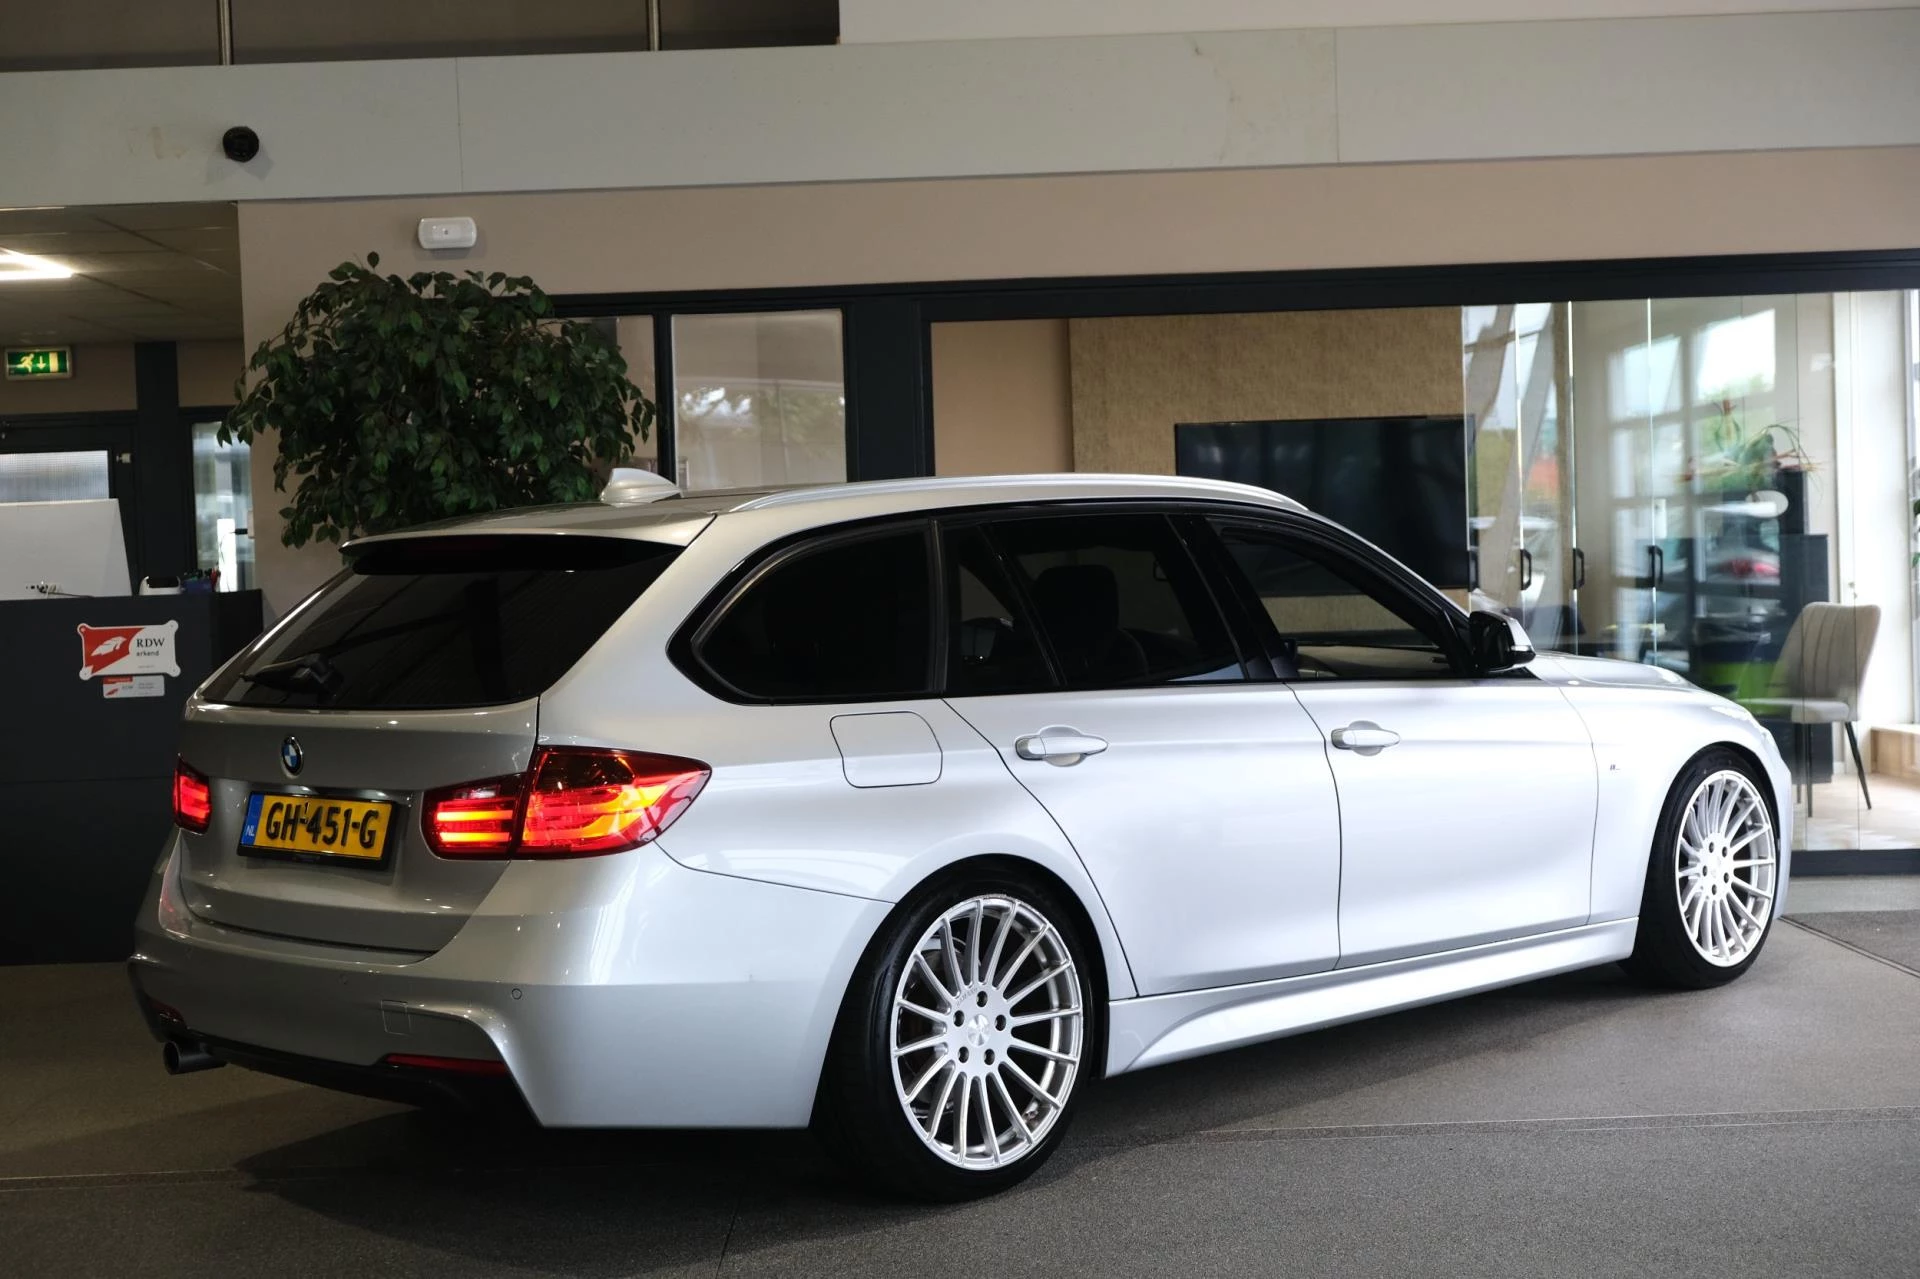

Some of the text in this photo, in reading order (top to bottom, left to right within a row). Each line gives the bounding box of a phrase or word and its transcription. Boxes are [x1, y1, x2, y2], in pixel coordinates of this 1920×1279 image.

[136, 638, 165, 648] RDW
[245, 825, 255, 837] NL
[265, 802, 379, 849] GH-451-G
